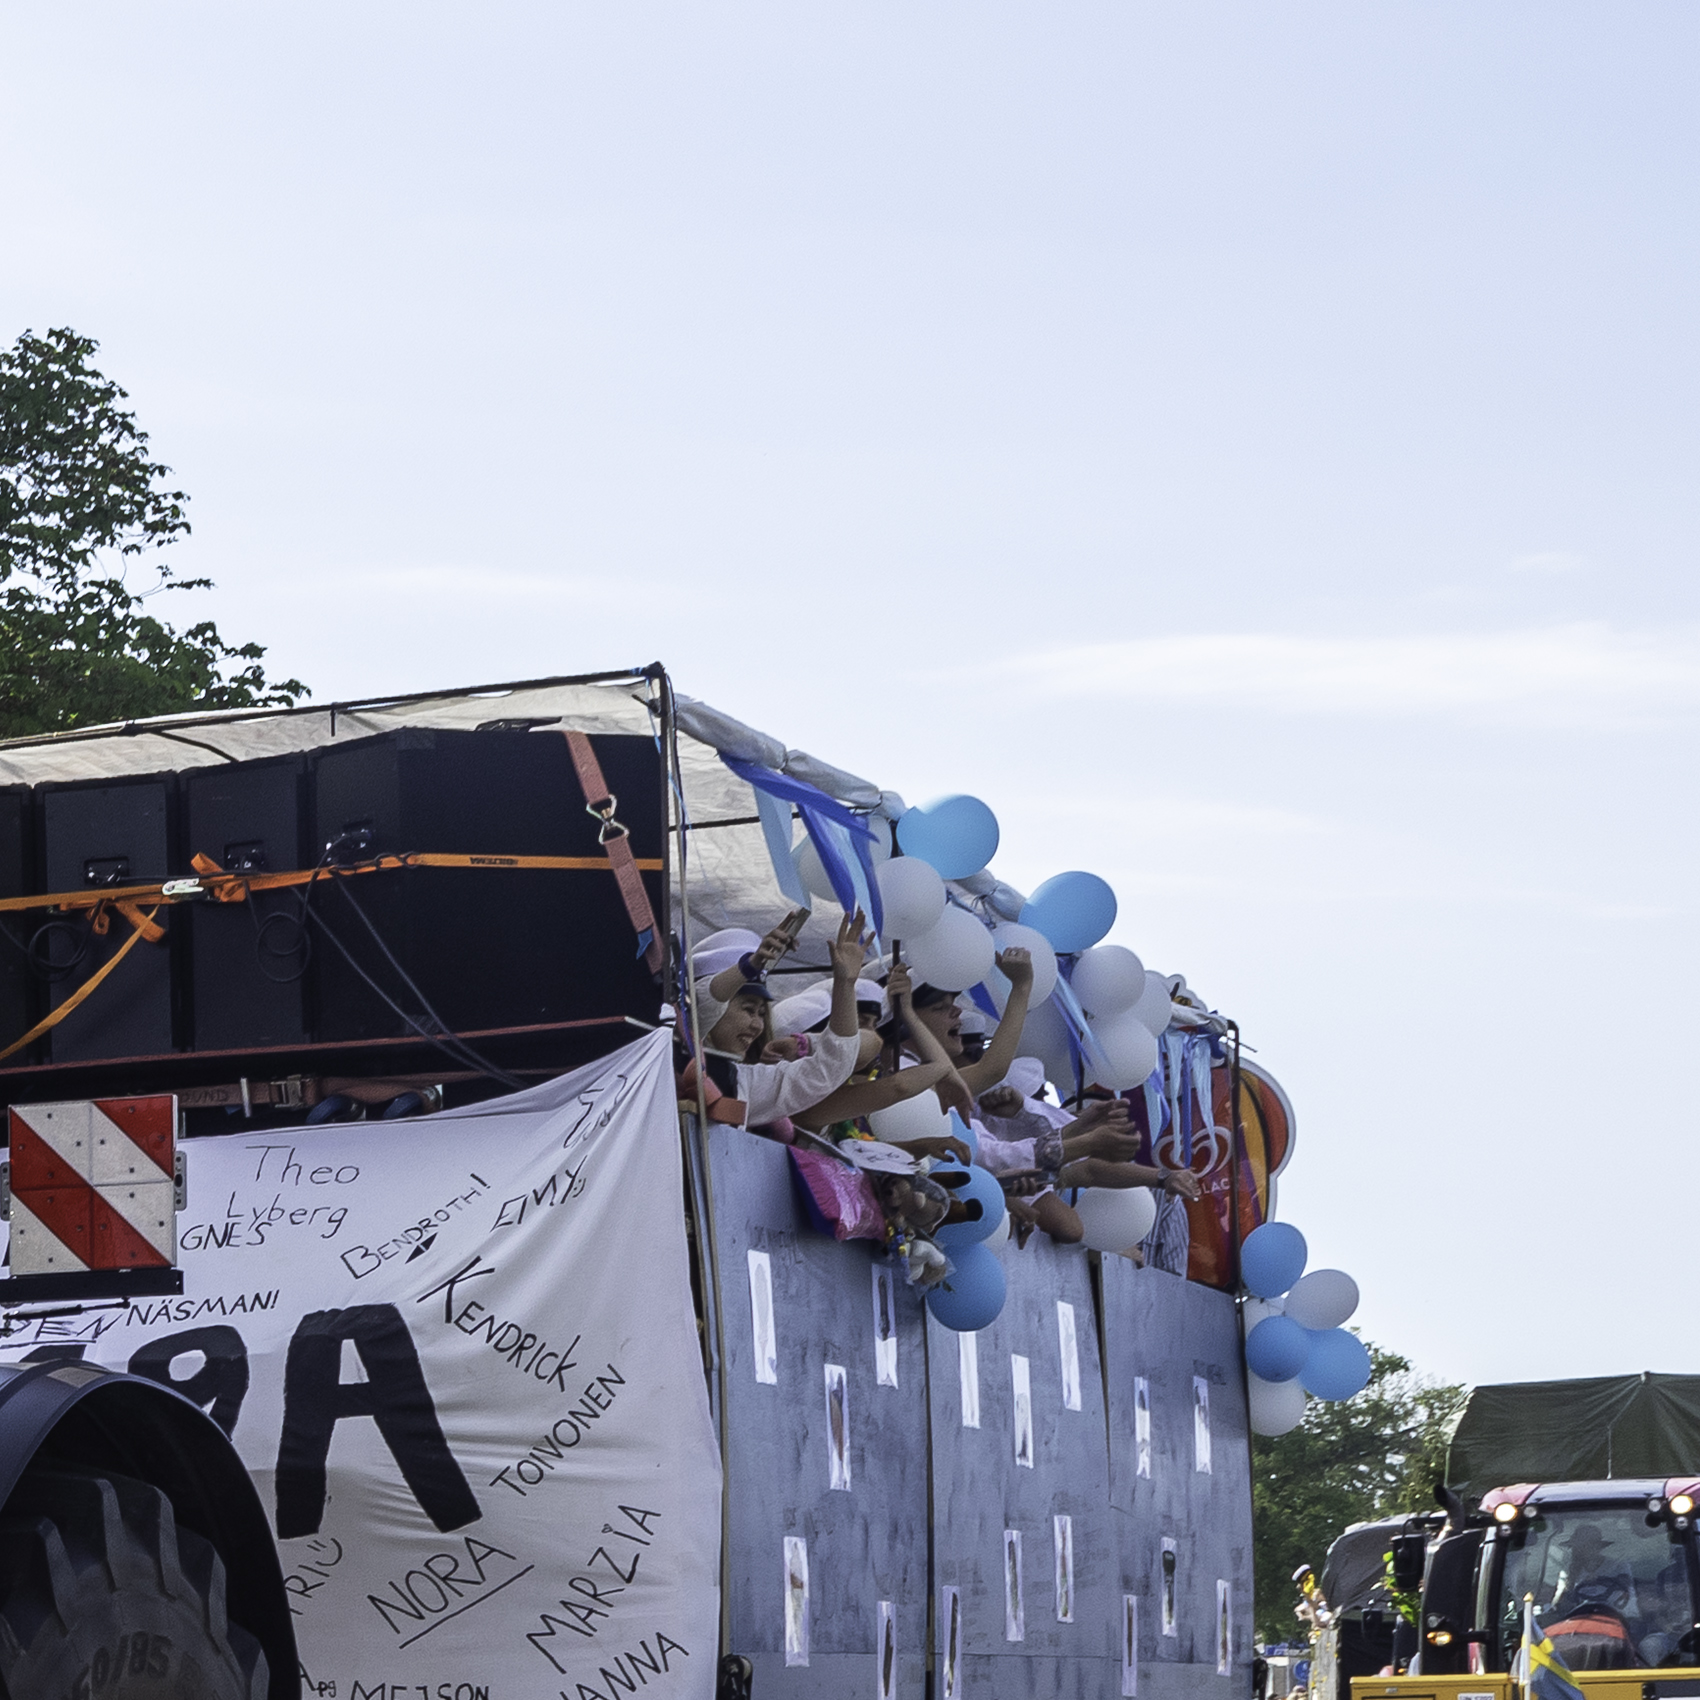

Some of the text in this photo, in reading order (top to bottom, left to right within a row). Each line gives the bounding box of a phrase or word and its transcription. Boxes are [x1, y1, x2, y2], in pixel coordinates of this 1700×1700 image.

[226, 1190, 349, 1239] Lyberg
[245, 1144, 360, 1187] Theo
[1198, 1177, 1232, 1195] LAC
[179, 1221, 274, 1251] GNES
[339, 1172, 491, 1280] BENDROTH!
[125, 1288, 280, 1327] NÄSMAN!
[416, 1255, 581, 1393] KENDRICK
[20, 1302, 483, 1541] 9A
[488, 1363, 626, 1497] TOIVONEN
[366, 1536, 517, 1635] NORA
[526, 1505, 662, 1675] MARZIA
